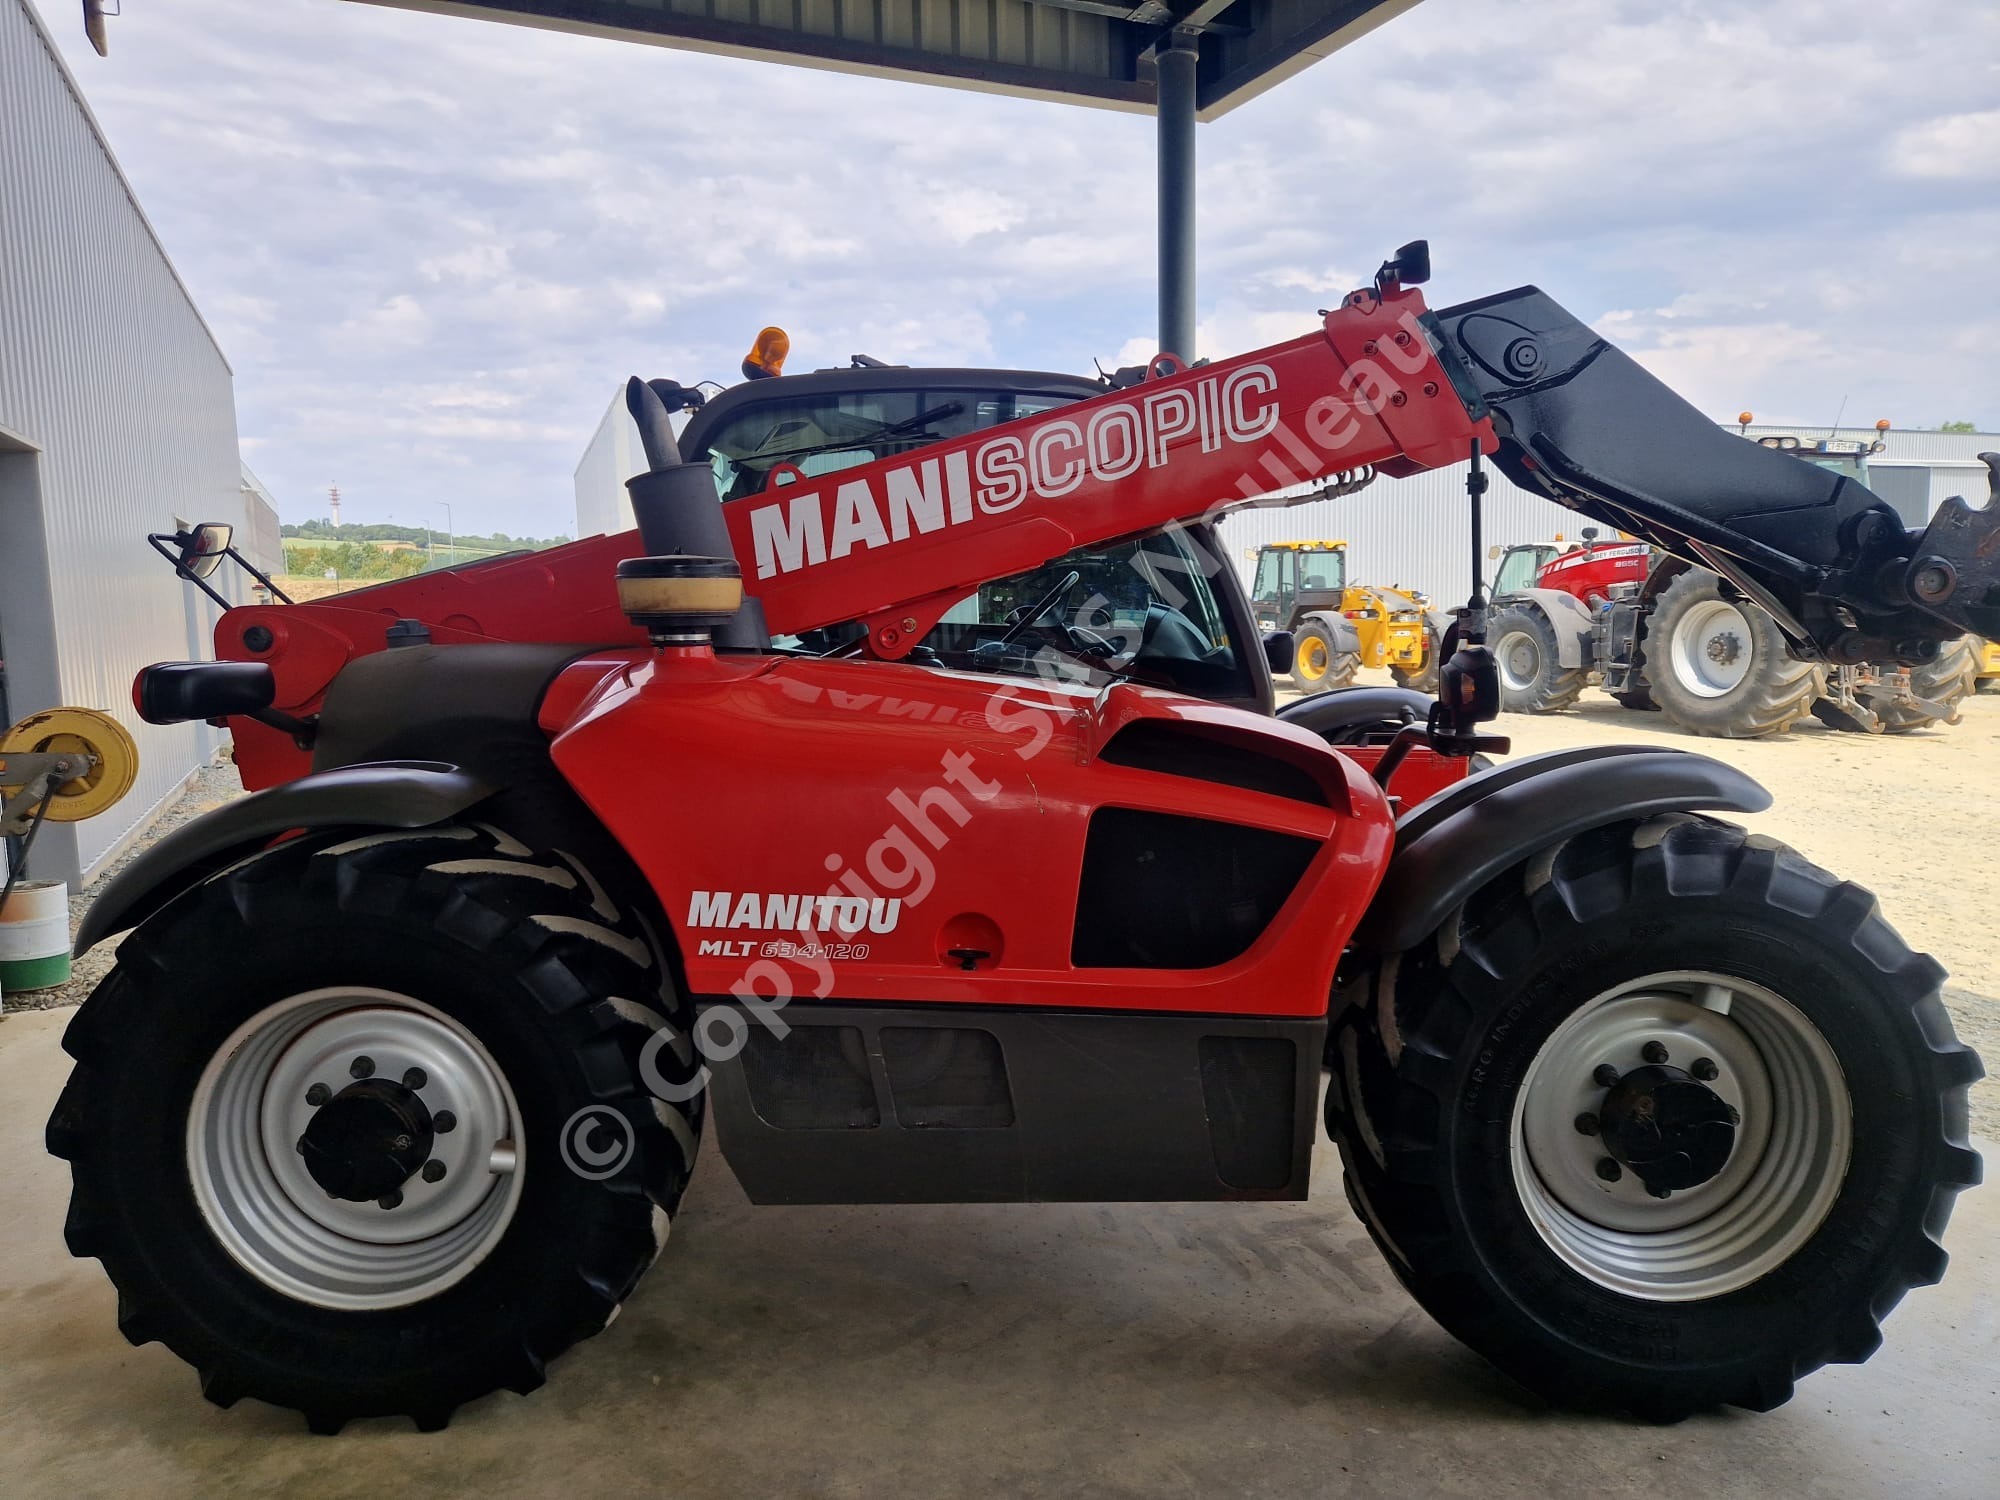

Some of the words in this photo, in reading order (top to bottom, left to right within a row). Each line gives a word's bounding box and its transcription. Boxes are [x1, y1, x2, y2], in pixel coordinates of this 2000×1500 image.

[750, 364, 1279, 581] MANISCOPIC
[1258, 620, 1276, 630] JCB
[687, 890, 901, 934] MANITOU
[698, 939, 758, 957] MLT
[760, 941, 870, 960] 634-120
